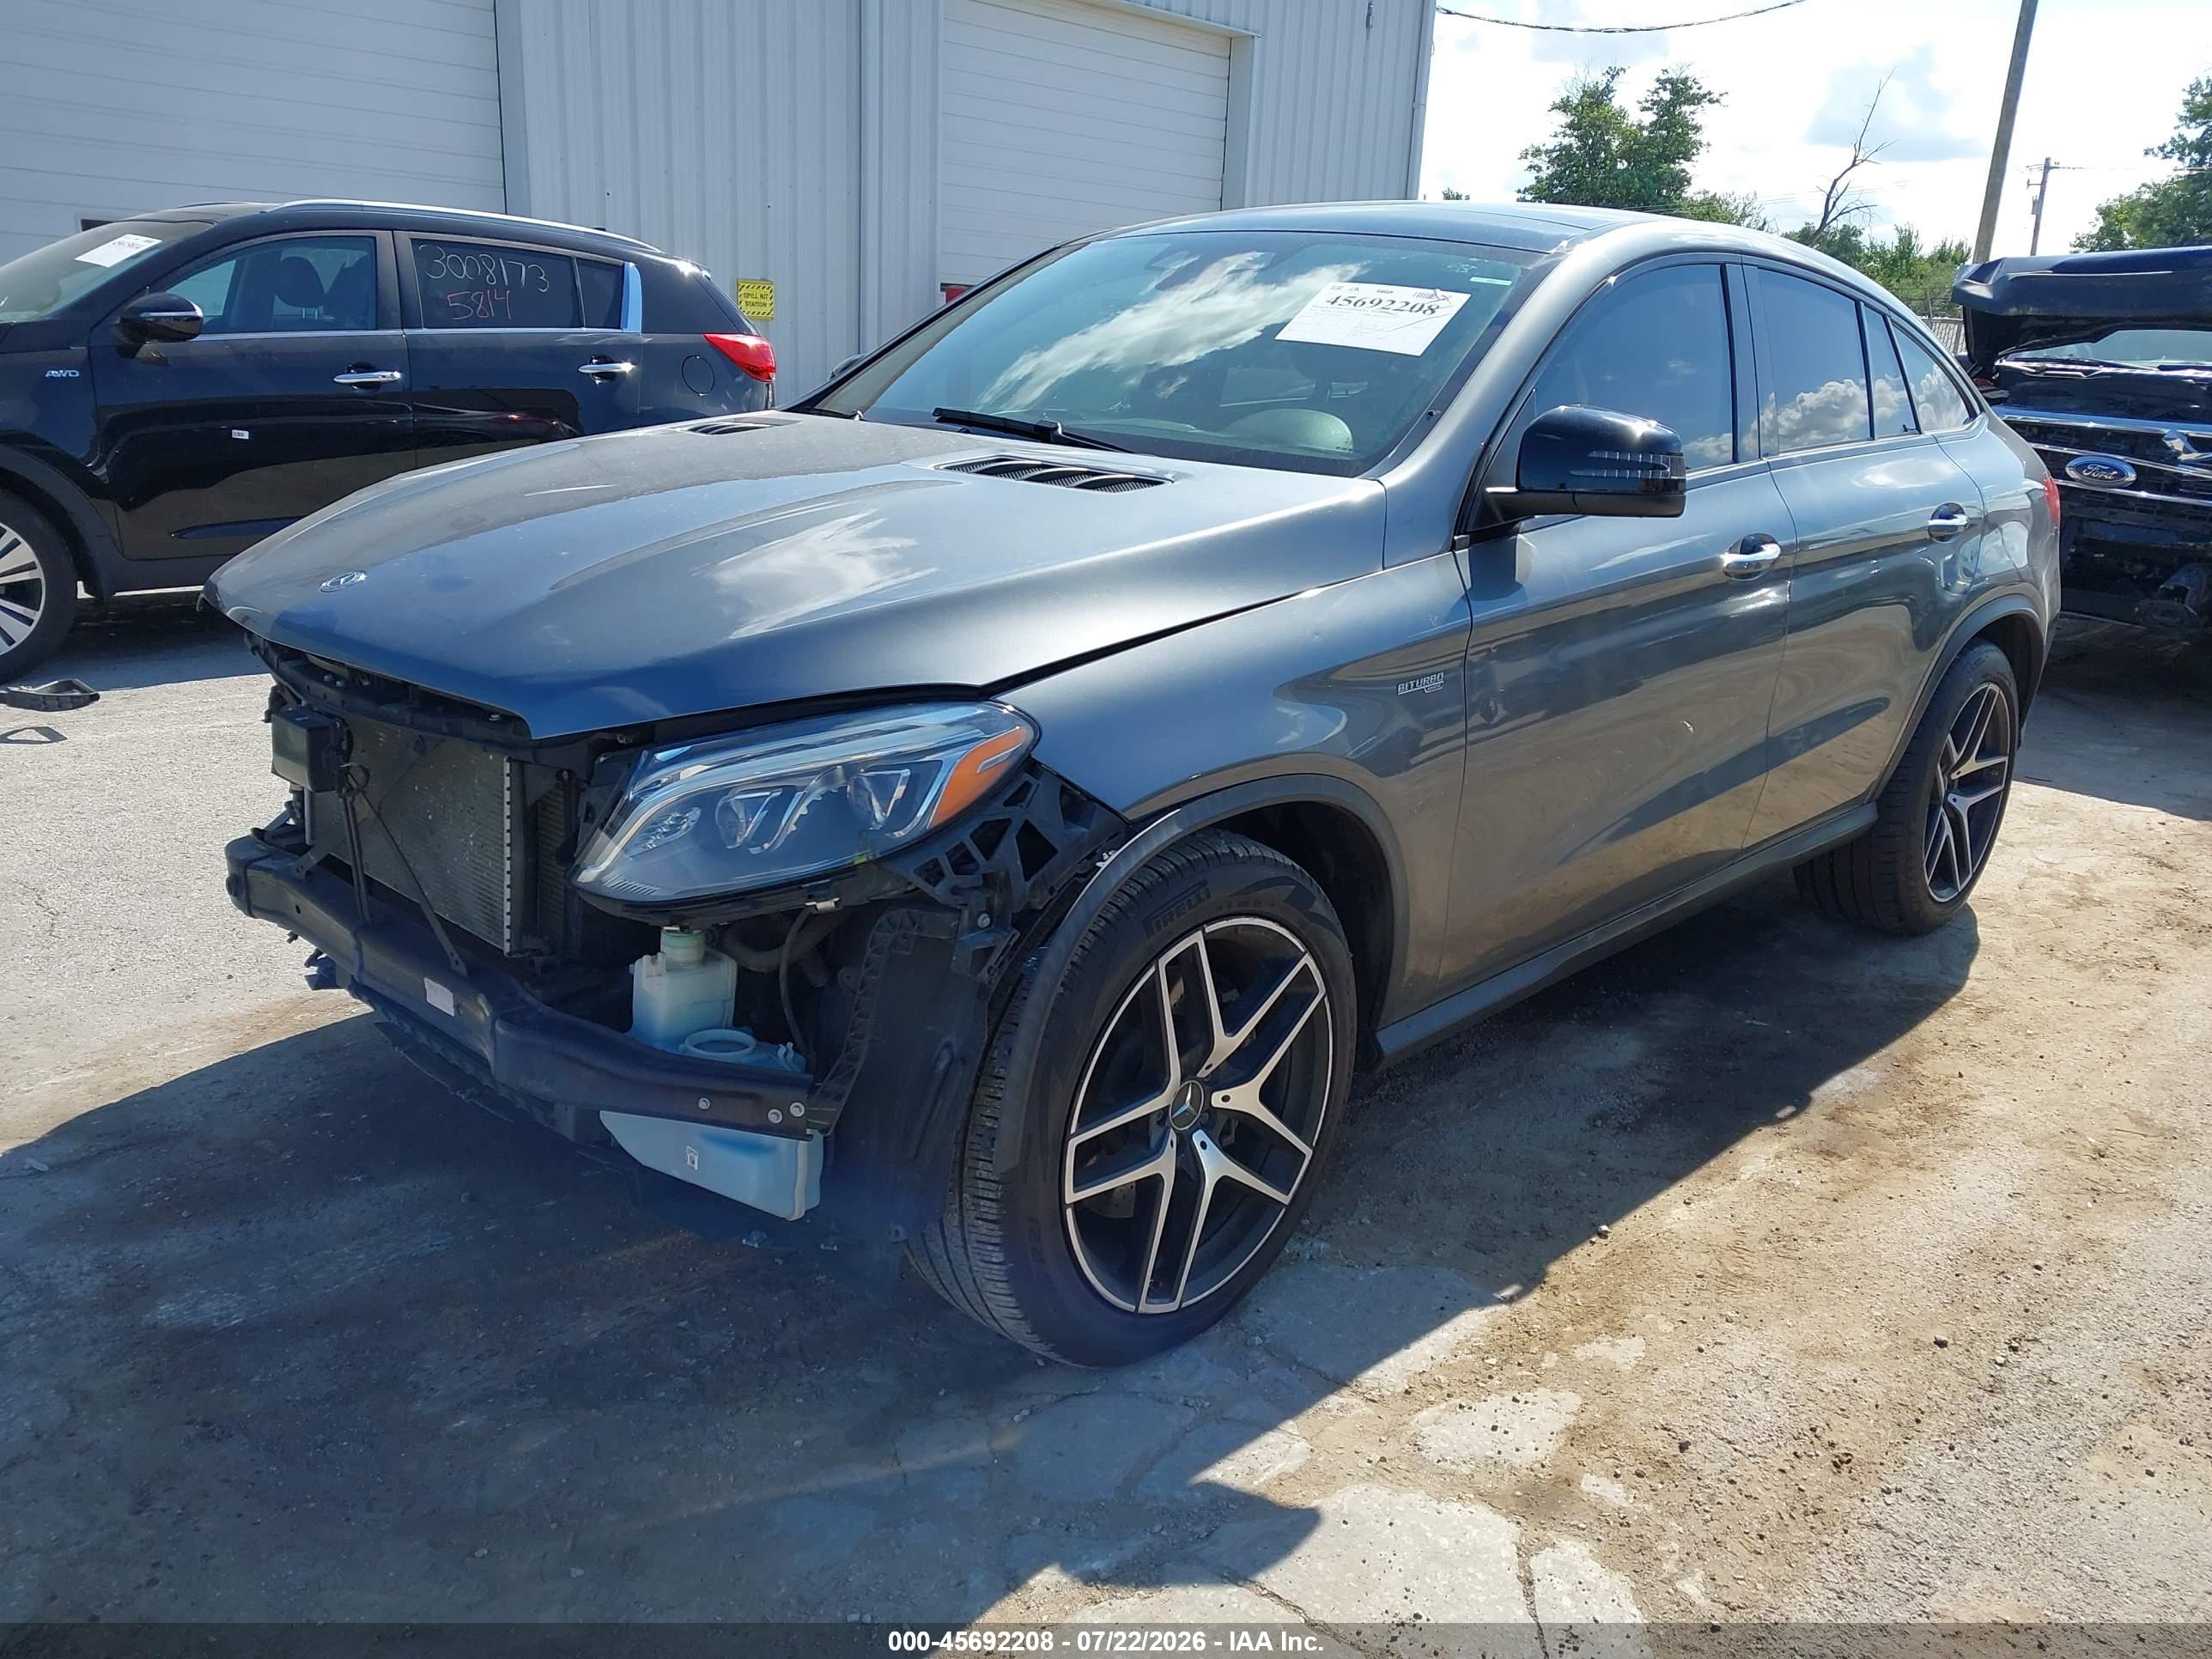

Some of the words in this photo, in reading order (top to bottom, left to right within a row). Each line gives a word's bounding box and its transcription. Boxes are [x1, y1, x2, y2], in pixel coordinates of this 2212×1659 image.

[419, 245, 550, 293] 3008173
[447, 289, 512, 320] 5814
[1326, 295, 1440, 316] 45692208
[45, 369, 80, 378] AWD
[2081, 464, 2118, 480] Ford
[1397, 672, 1444, 694] BITURBO
[1142, 879, 1211, 938] PIRELLI
